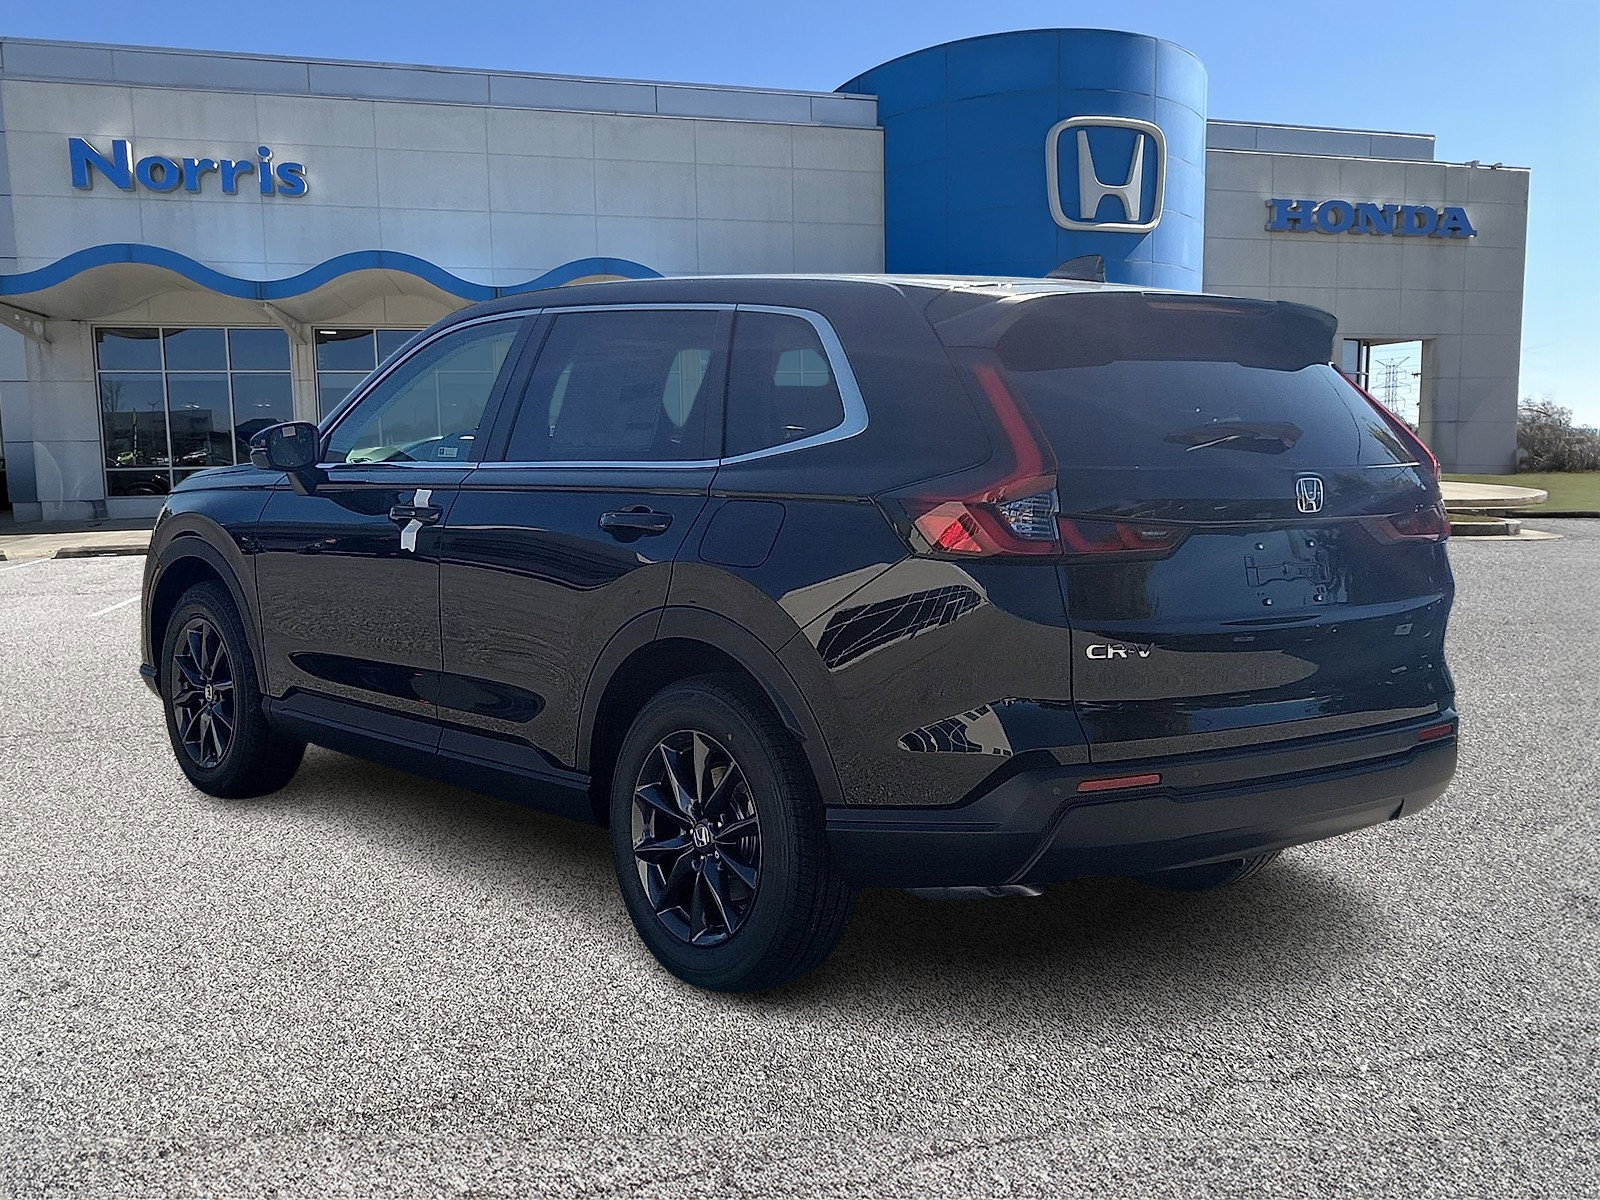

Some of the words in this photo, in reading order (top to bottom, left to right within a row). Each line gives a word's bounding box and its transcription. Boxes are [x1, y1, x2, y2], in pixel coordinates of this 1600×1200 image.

[68, 137, 308, 197] Norris
[1266, 198, 1477, 239] HONDA
[1085, 643, 1155, 659] CR-V
